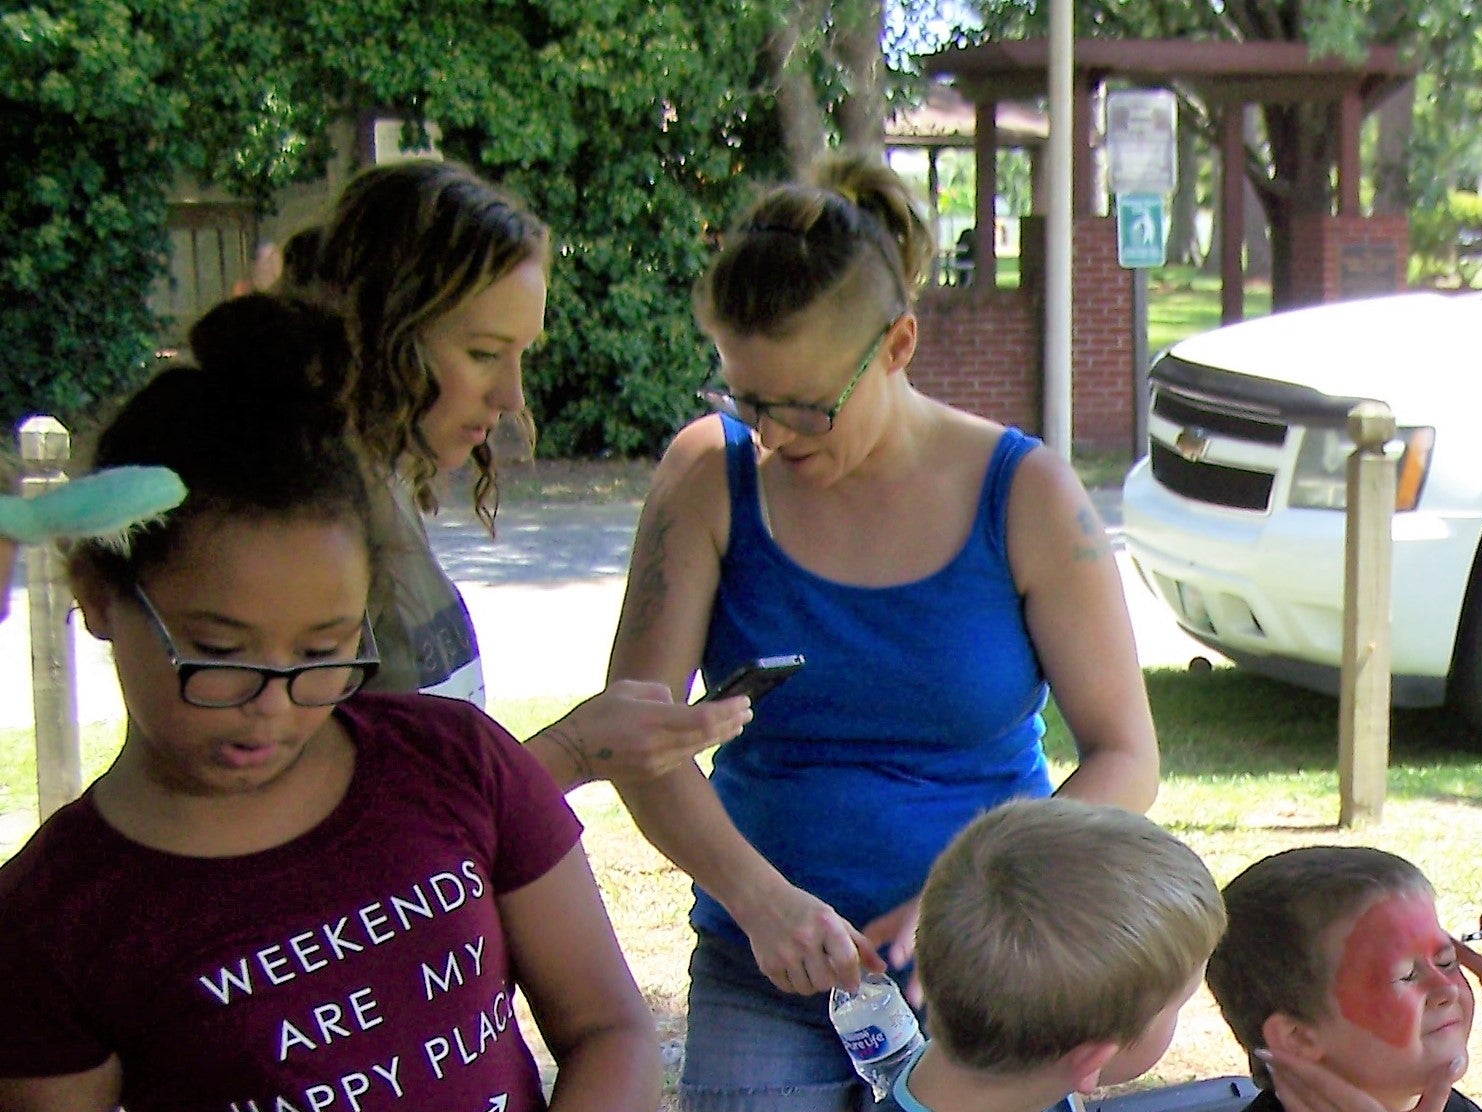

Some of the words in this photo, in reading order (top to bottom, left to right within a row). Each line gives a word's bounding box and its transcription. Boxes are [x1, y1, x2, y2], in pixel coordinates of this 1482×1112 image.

[199, 860, 485, 1004] WEEKENDS
[280, 987, 384, 1061] ARE
[421, 936, 485, 1001] MY
